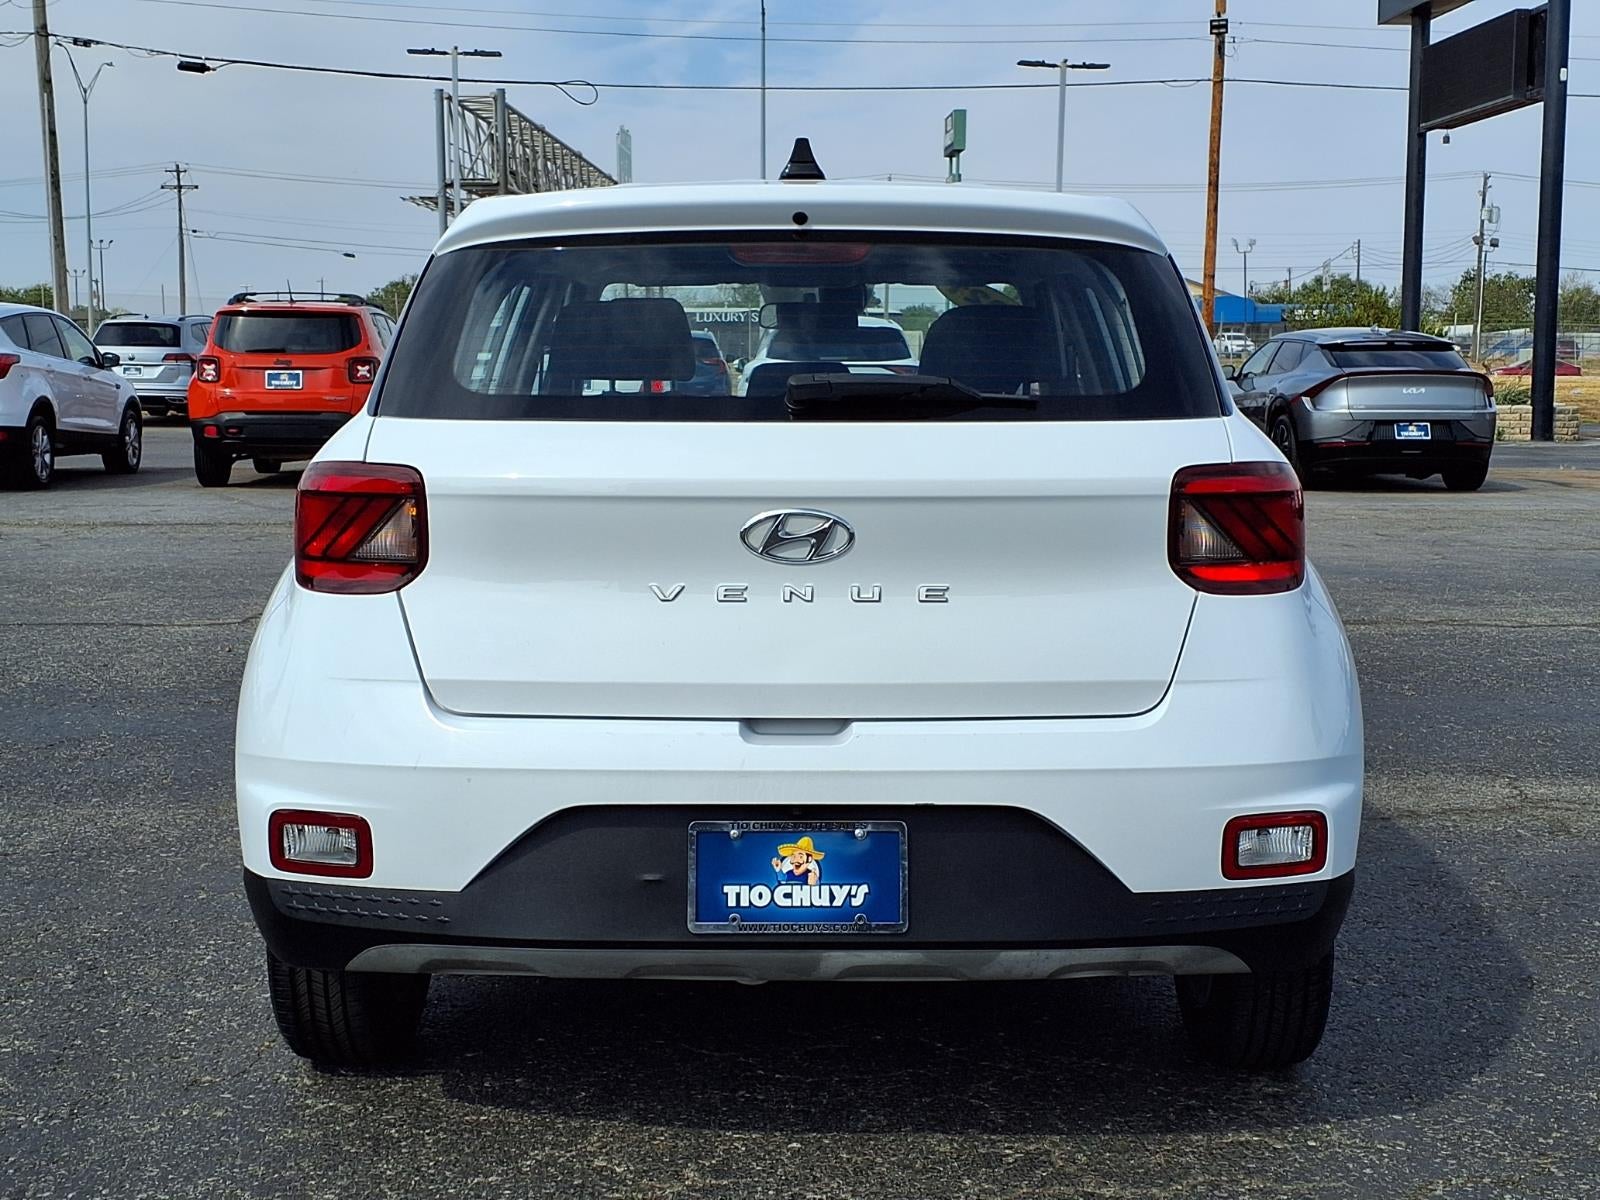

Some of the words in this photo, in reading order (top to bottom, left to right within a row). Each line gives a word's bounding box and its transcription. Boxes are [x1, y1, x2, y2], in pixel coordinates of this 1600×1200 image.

[696, 312, 747, 322] LUXURY
[649, 583, 950, 603] VENUE
[729, 822, 749, 830] TIO
[799, 822, 828, 831] AUTO
[831, 822, 867, 831] SALES
[723, 884, 772, 907] TIO
[773, 884, 869, 907] CHUY'S
[738, 923, 858, 932] WWW.TIOCHUYS.COM
